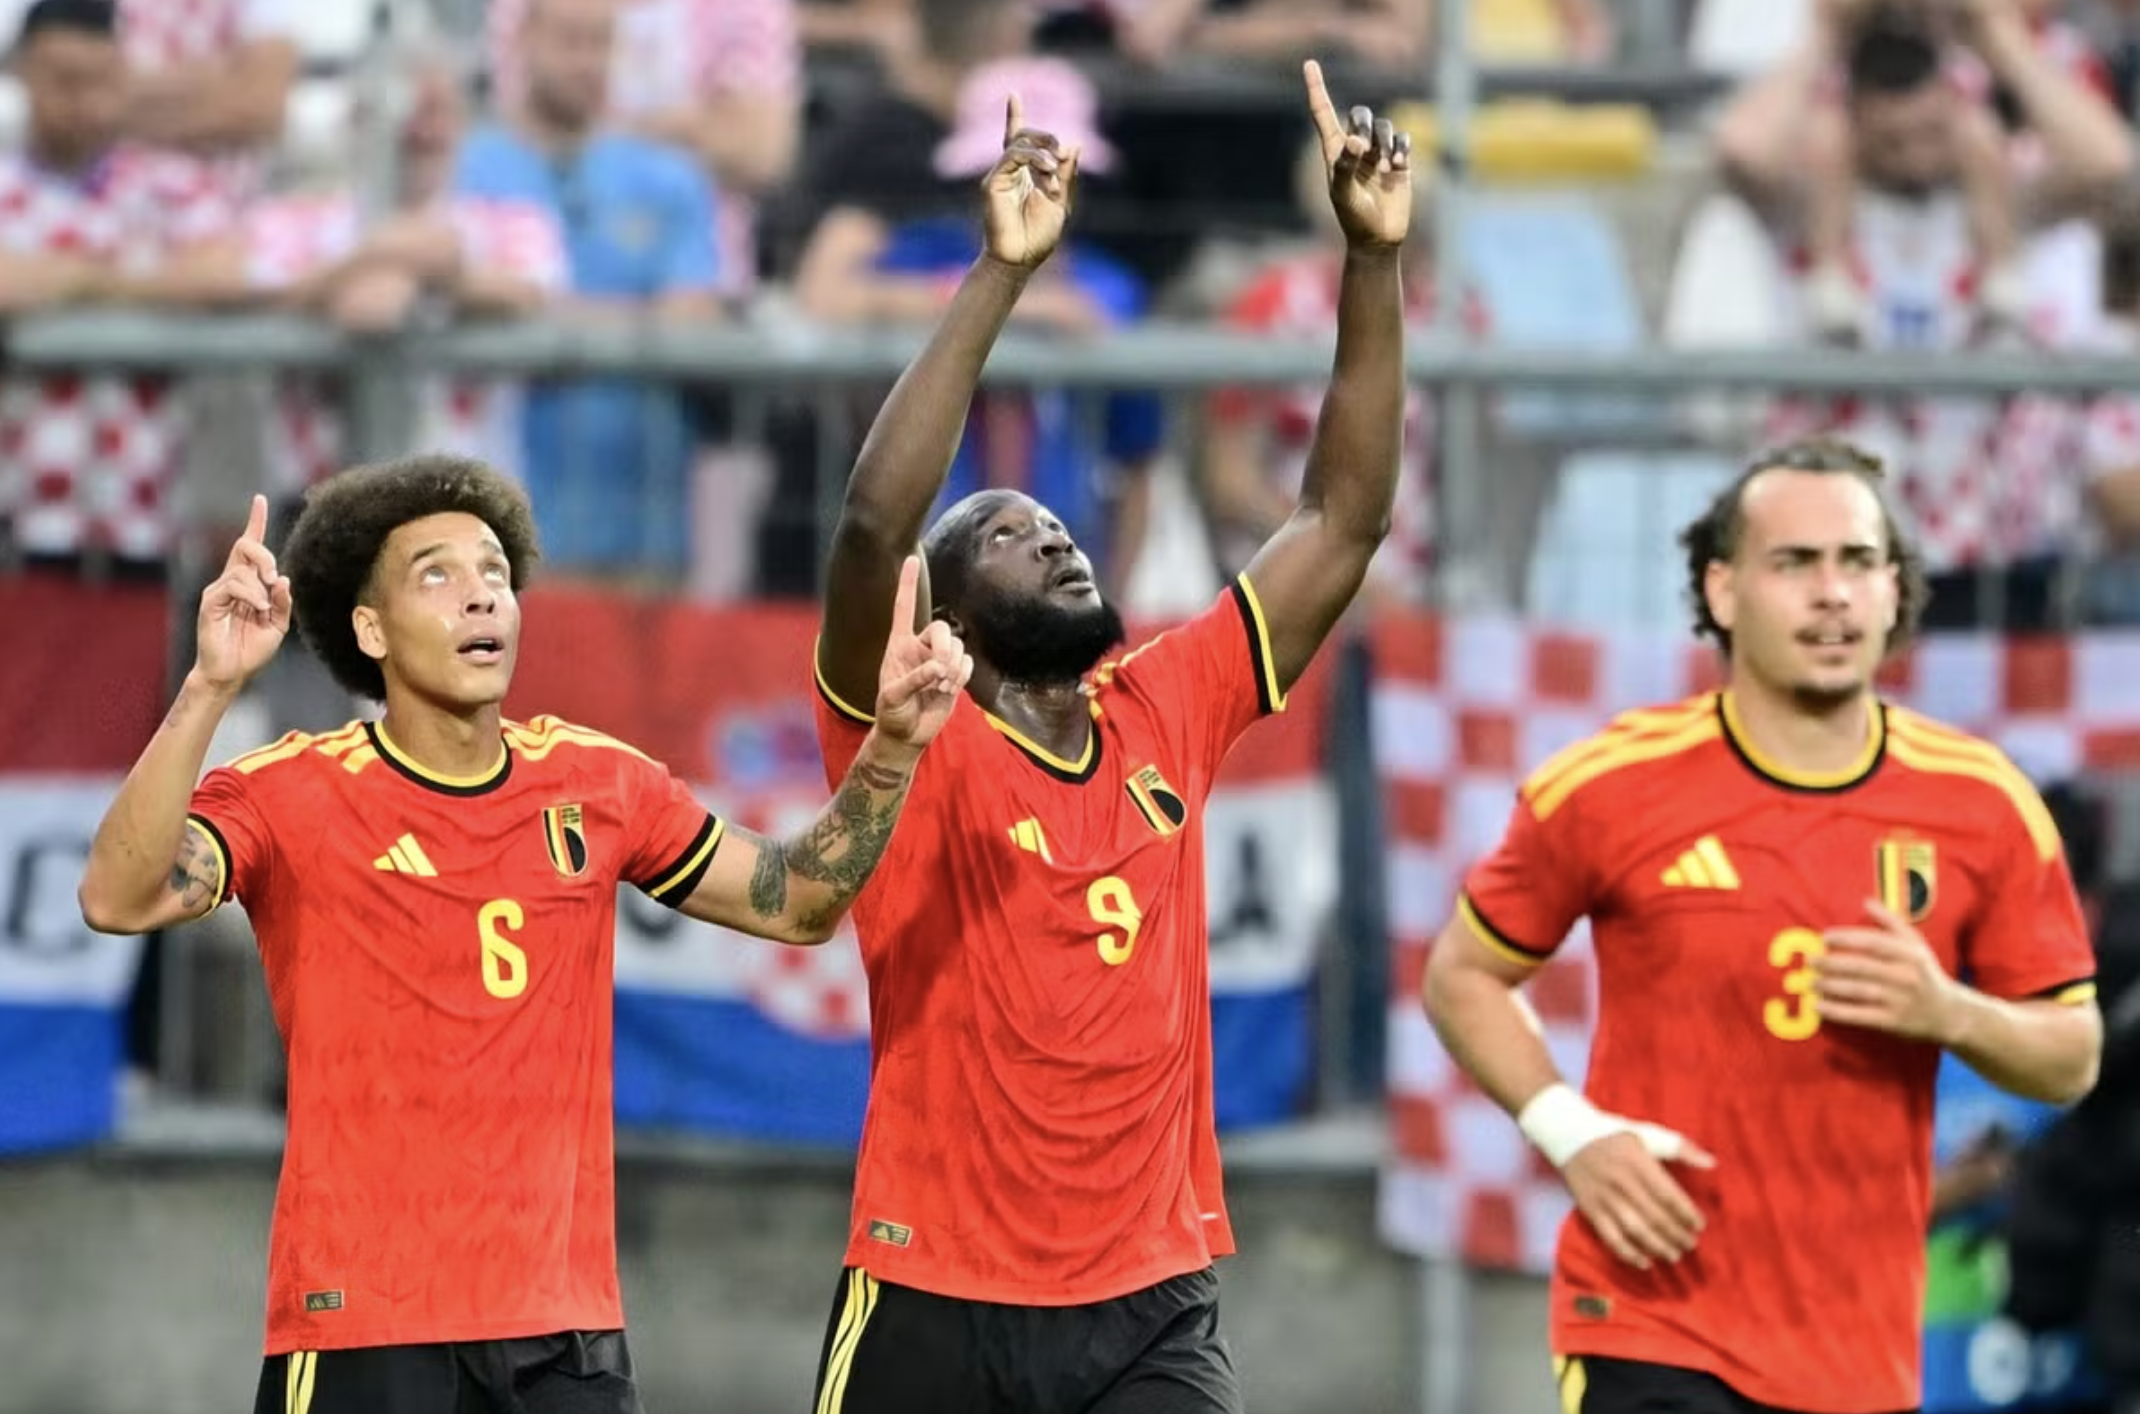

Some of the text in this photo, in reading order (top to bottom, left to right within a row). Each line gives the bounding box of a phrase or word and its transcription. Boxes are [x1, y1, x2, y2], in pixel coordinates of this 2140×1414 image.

[478, 898, 528, 999] 6
[1087, 876, 1141, 966] 9
[1763, 927, 1824, 1041] 3
